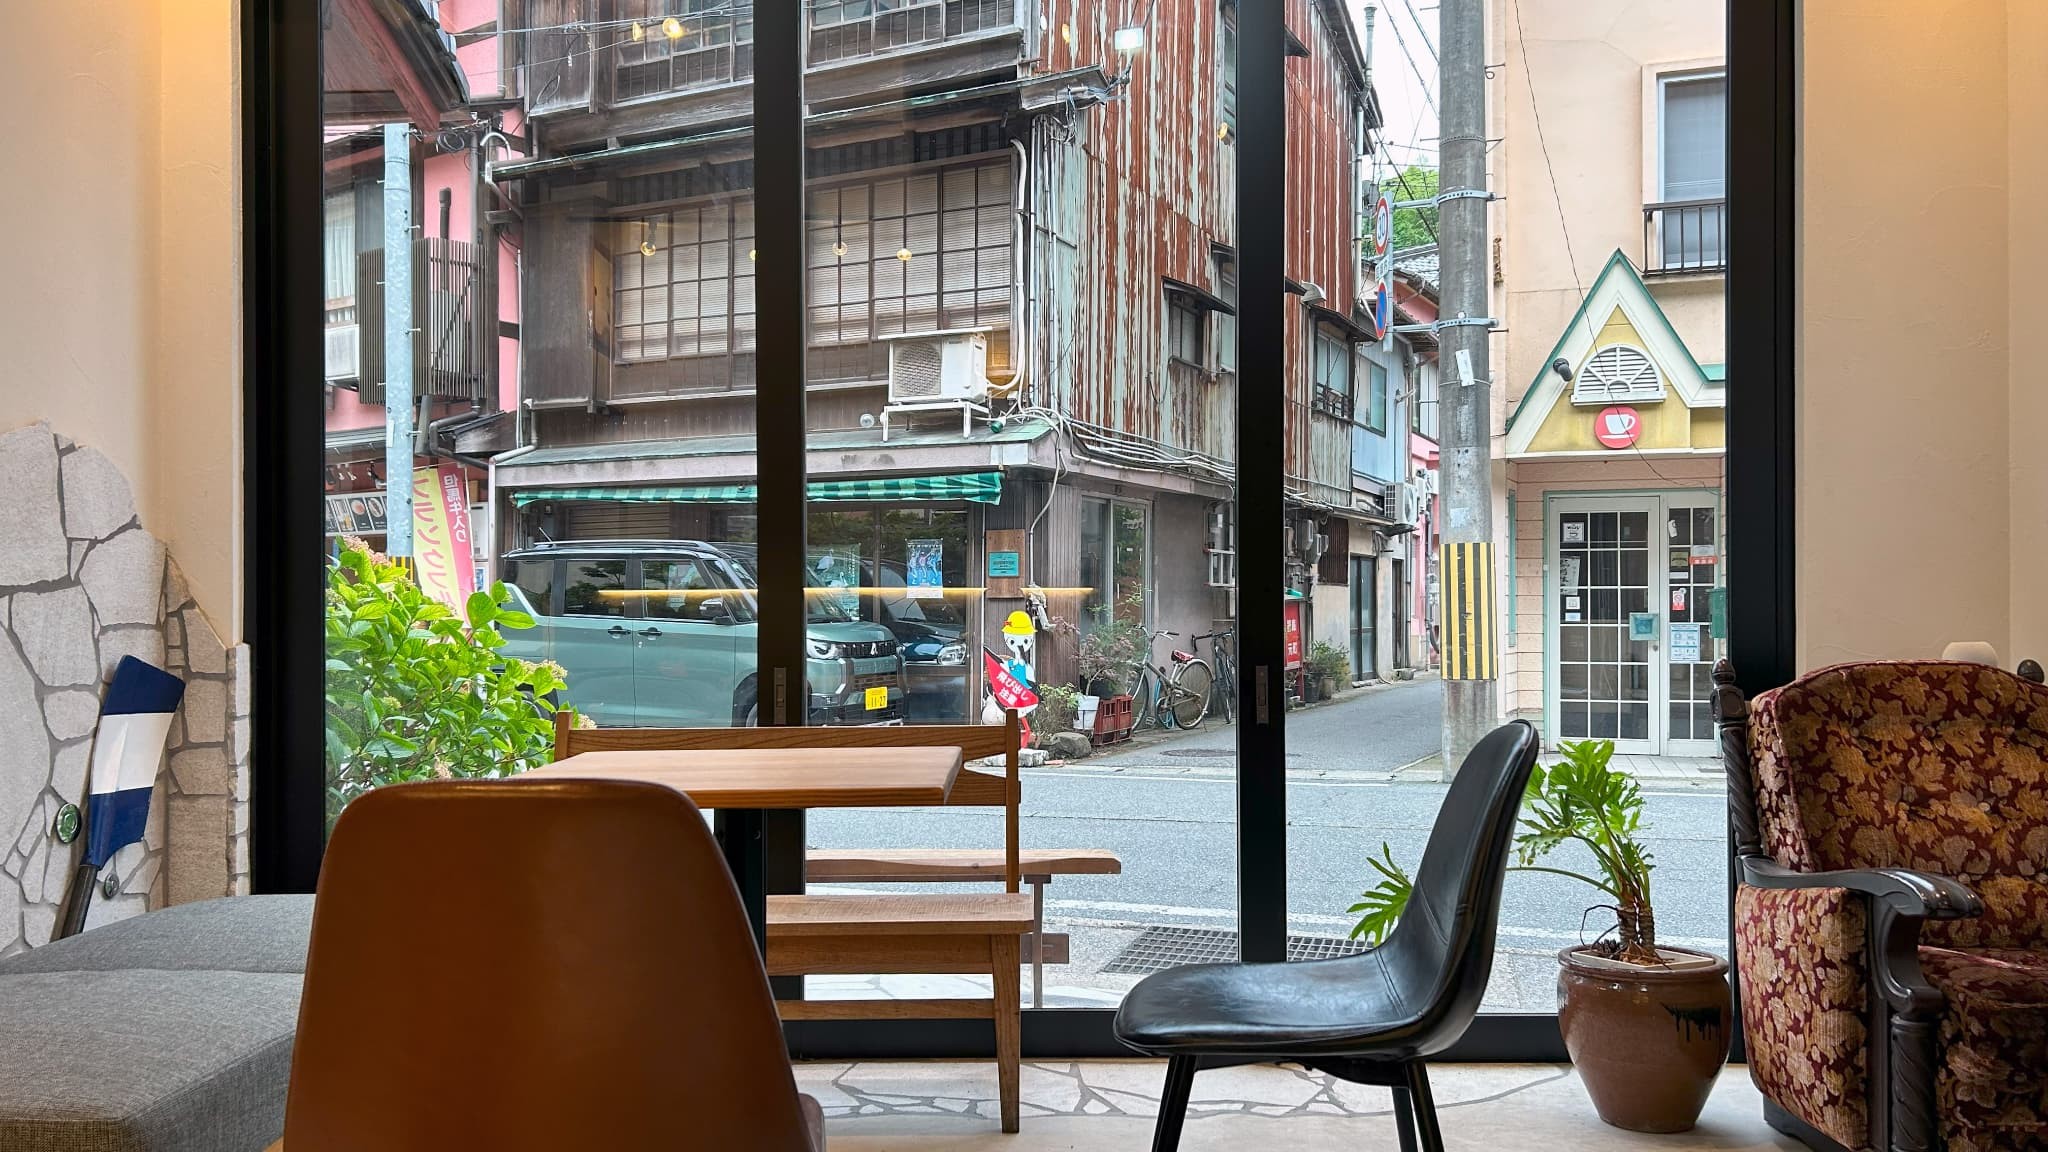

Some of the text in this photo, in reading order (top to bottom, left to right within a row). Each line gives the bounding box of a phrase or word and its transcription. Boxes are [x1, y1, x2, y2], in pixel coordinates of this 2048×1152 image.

[1378, 212, 1386, 240] 30
[996, 671, 1029, 701] 飛び出し
